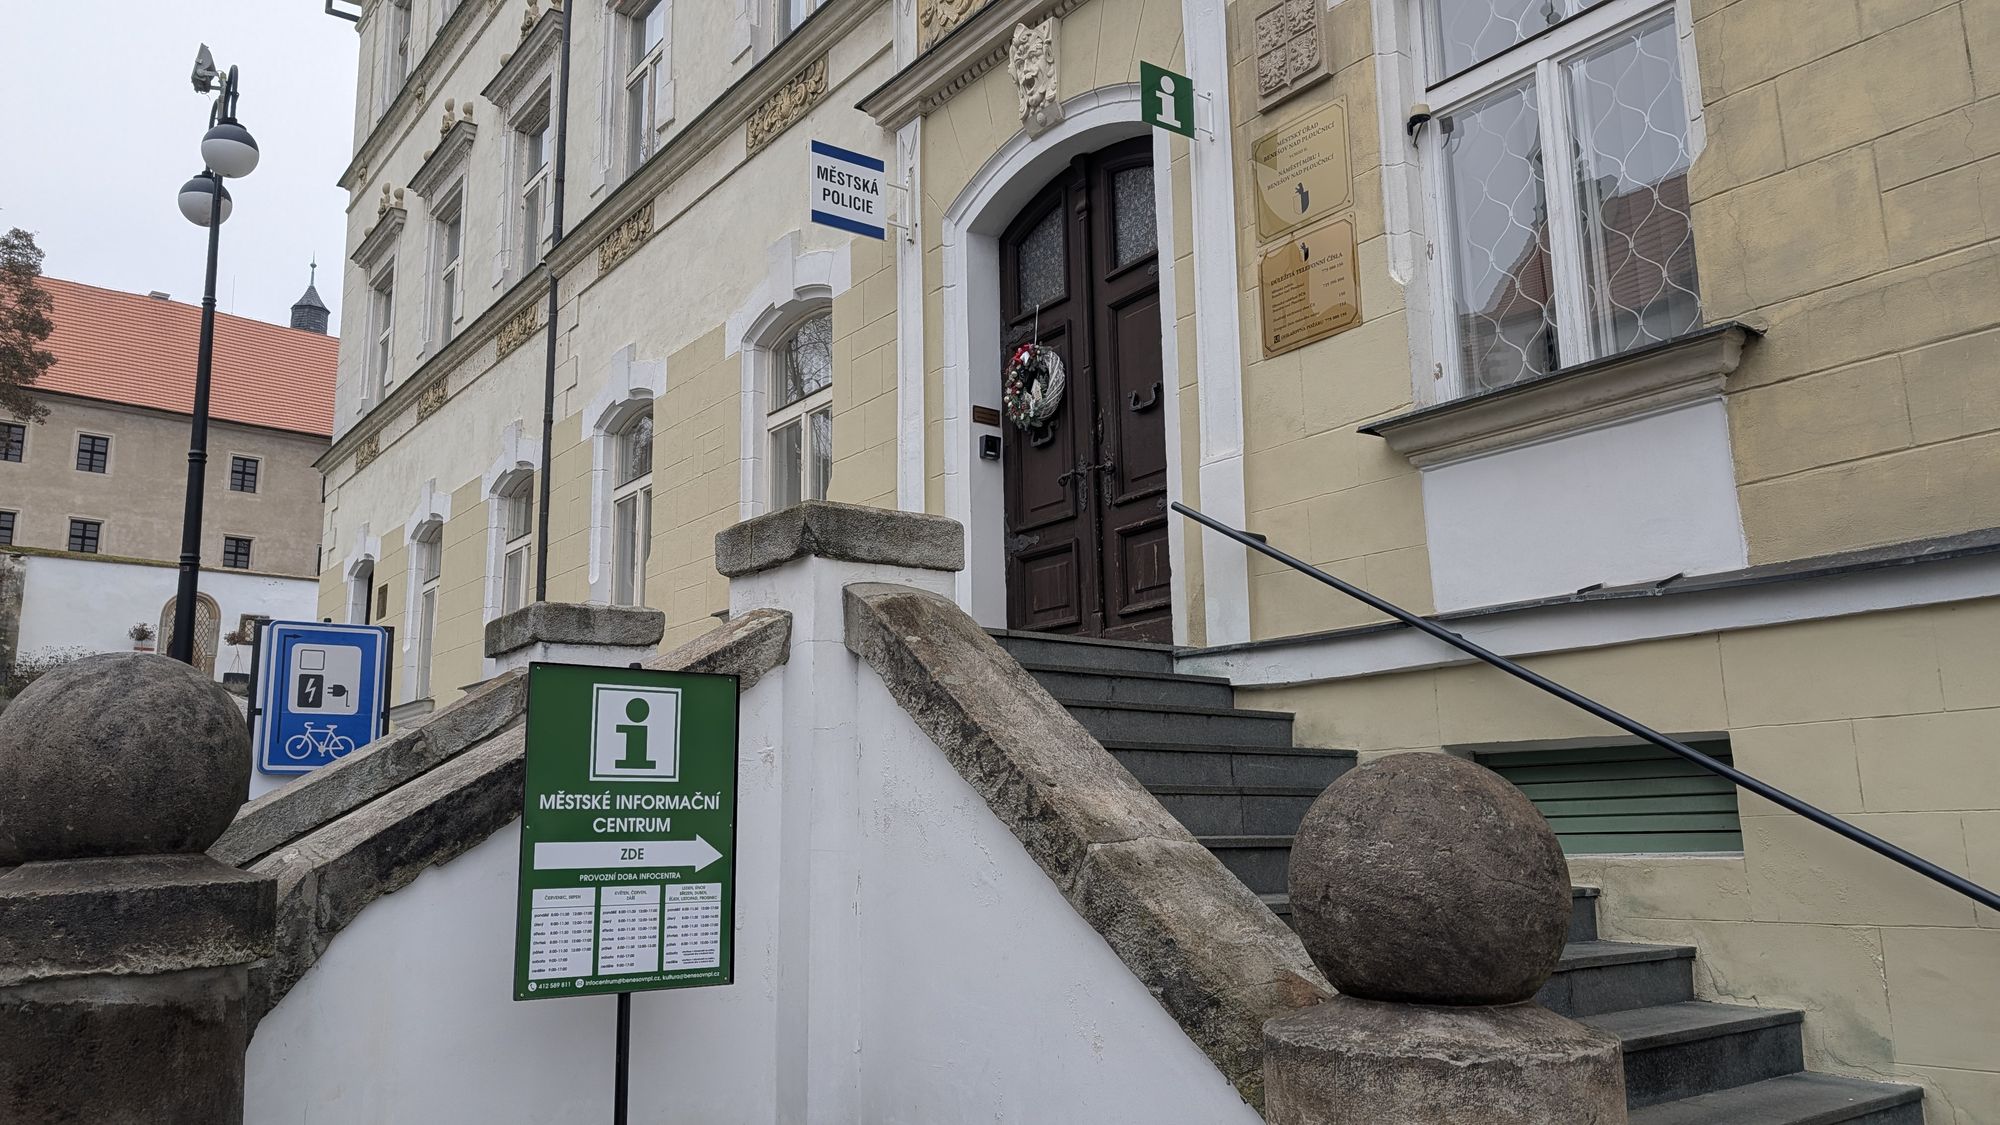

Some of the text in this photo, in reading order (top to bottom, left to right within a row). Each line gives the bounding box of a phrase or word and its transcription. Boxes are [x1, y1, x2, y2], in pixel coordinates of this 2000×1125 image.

[1264, 121, 1334, 162] BENEŠOV NAD PLOUČNICÍ
[817, 165, 879, 195] MĚSTSKÁ
[1267, 153, 1334, 190] BENEŠOV NAD PLOUČNICÍ
[823, 188, 873, 214] POLICIE
[1296, 258, 1326, 275] TELEFONNÍ
[1326, 252, 1343, 262] ČÍSLA
[539, 790, 721, 809] MĚSTSKÉ INFORMAČNÍ
[593, 817, 670, 833] CENTRUM
[620, 848, 644, 860] ZDE
[580, 872, 616, 881] PROVOZNÍ
